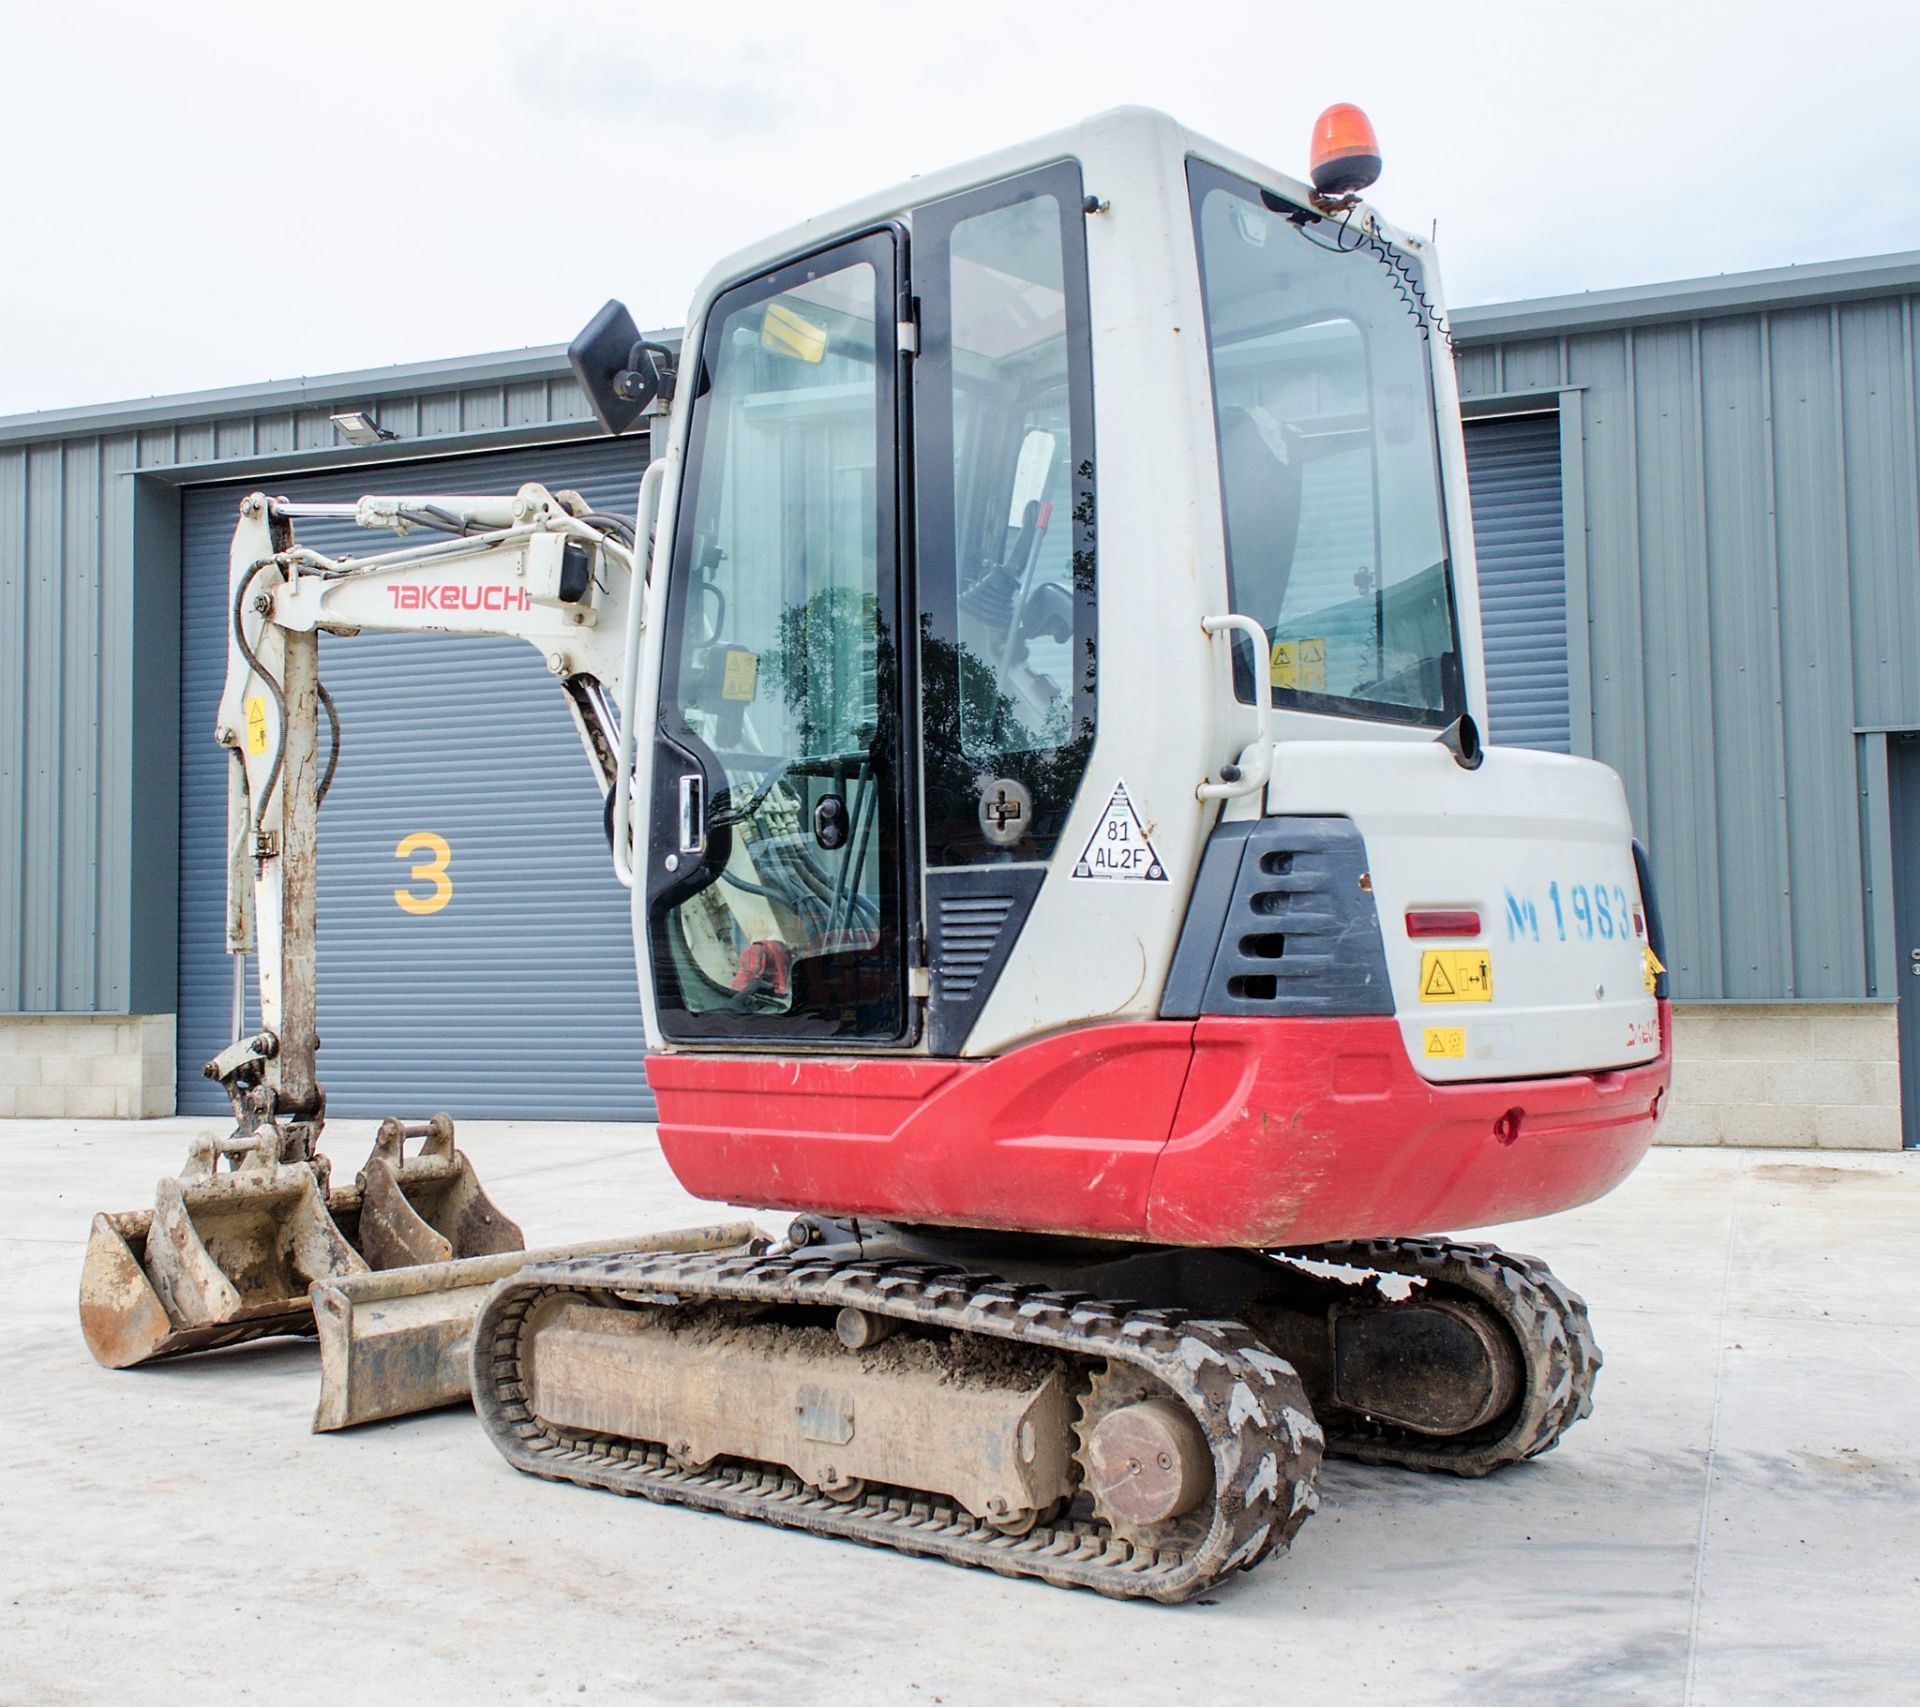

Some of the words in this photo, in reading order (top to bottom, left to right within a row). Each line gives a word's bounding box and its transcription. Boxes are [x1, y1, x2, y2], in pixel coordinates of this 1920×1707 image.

[1107, 821, 1130, 841] 81
[1095, 847, 1146, 869] AL2F
[393, 831, 453, 915] 3
